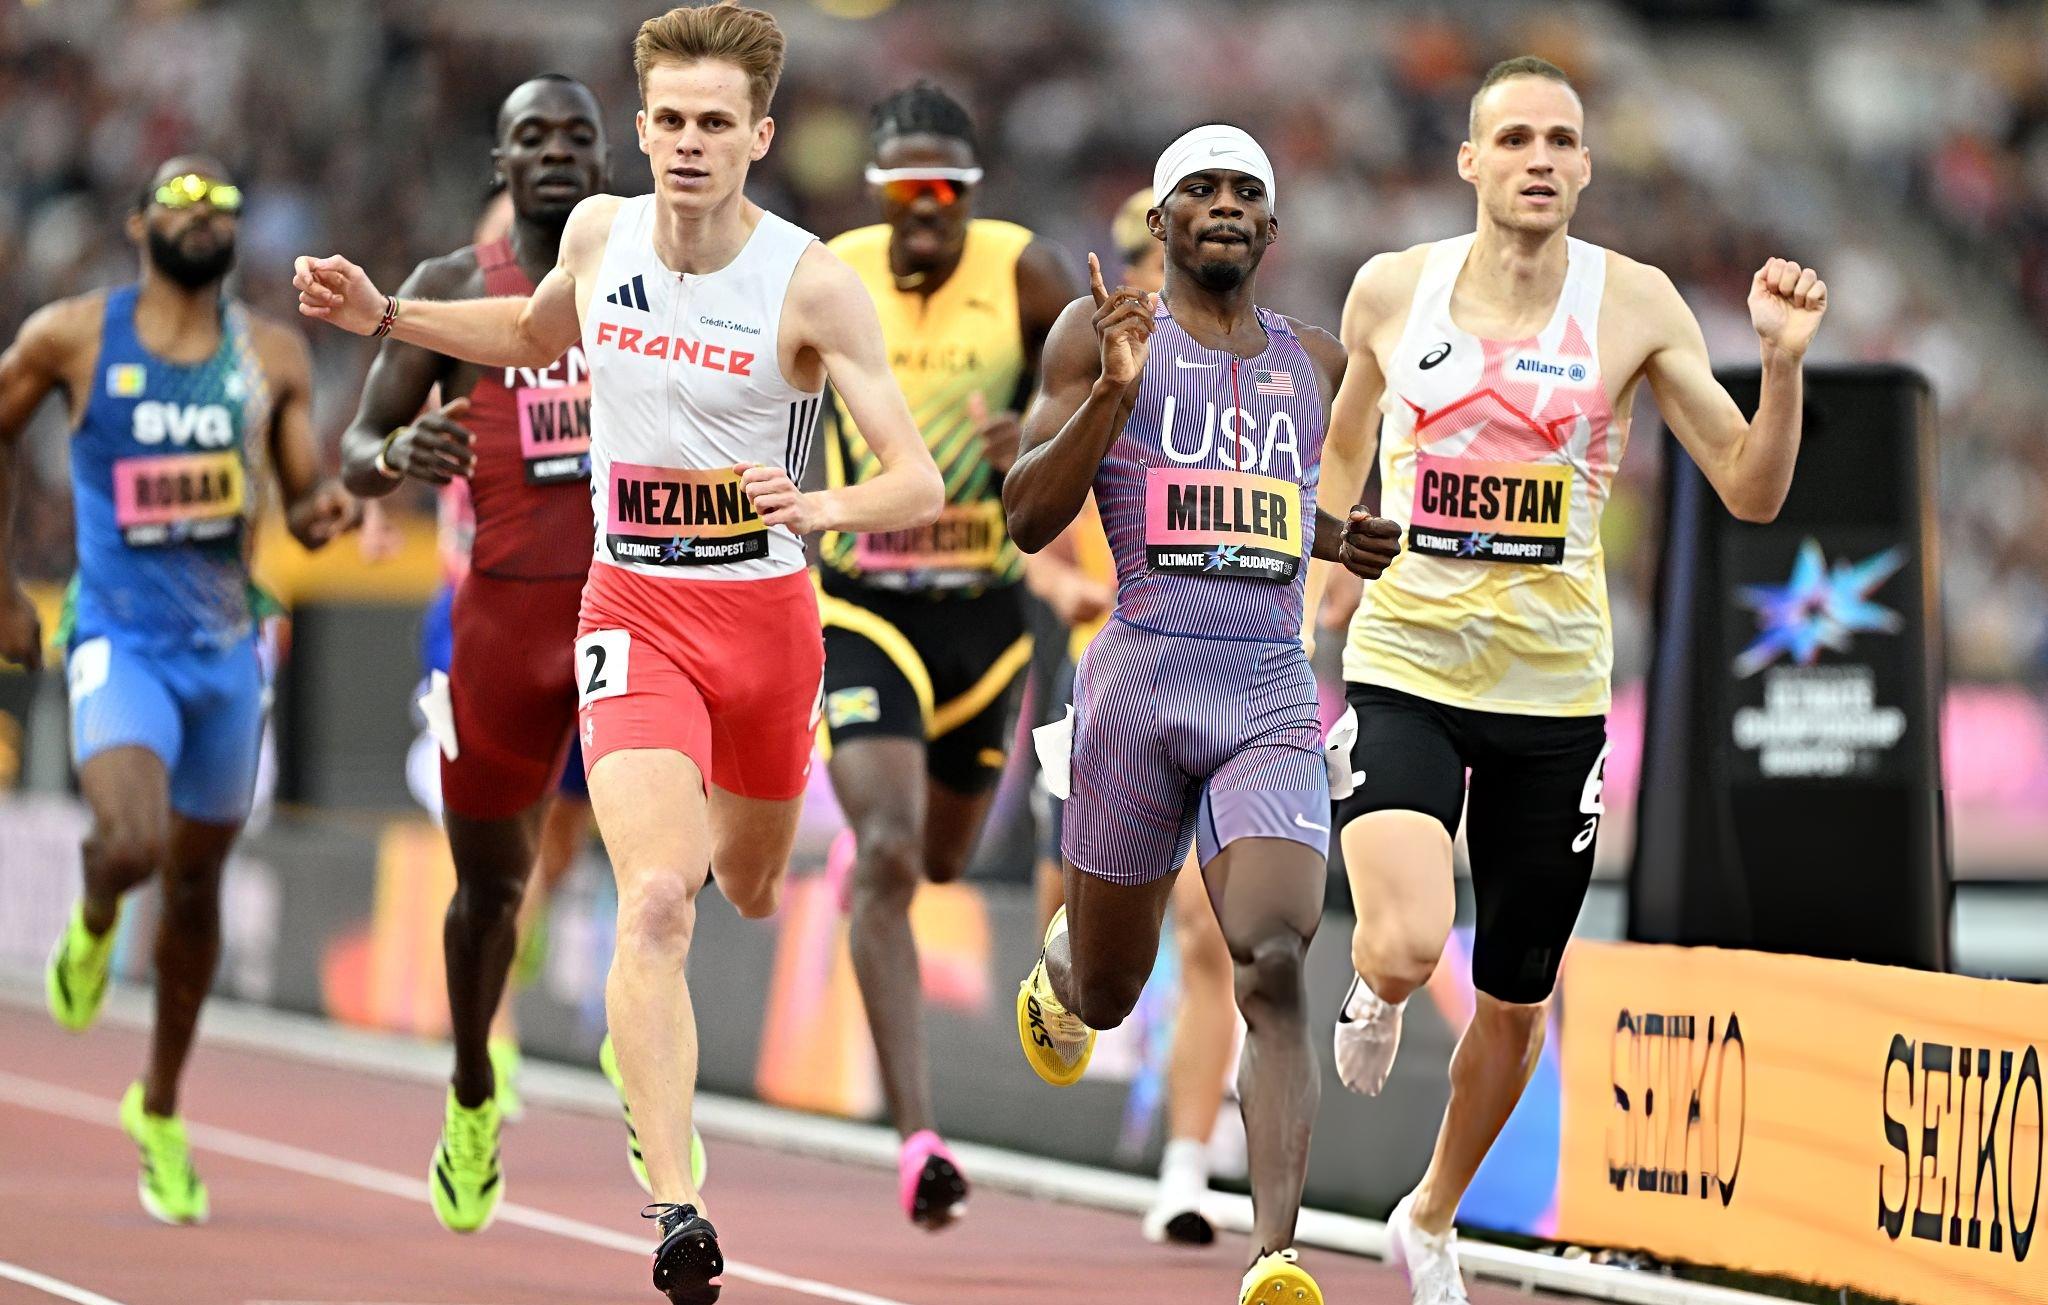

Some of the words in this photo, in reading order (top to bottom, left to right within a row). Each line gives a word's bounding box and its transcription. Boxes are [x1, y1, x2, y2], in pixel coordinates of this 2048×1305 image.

[596, 322, 755, 377] FRANCE
[699, 315, 724, 328] Crédit
[733, 322, 761, 336] Mutuel
[1515, 358, 1565, 377] Allianz
[1162, 396, 1302, 478] USA
[1167, 484, 1288, 541] MILLER
[1421, 469, 1564, 525] CRESTAN
[616, 542, 661, 558] ULTIMATE
[694, 541, 744, 558] BUDAPEST
[1158, 553, 1205, 567] ULTIMATE
[1239, 555, 1284, 573] BUDAPEST
[1416, 533, 1459, 551] ULTIMATE
[1492, 541, 1543, 557] BUDAPEST
[585, 644, 607, 695] 2
[1877, 1033, 2044, 1262] SEIKO
